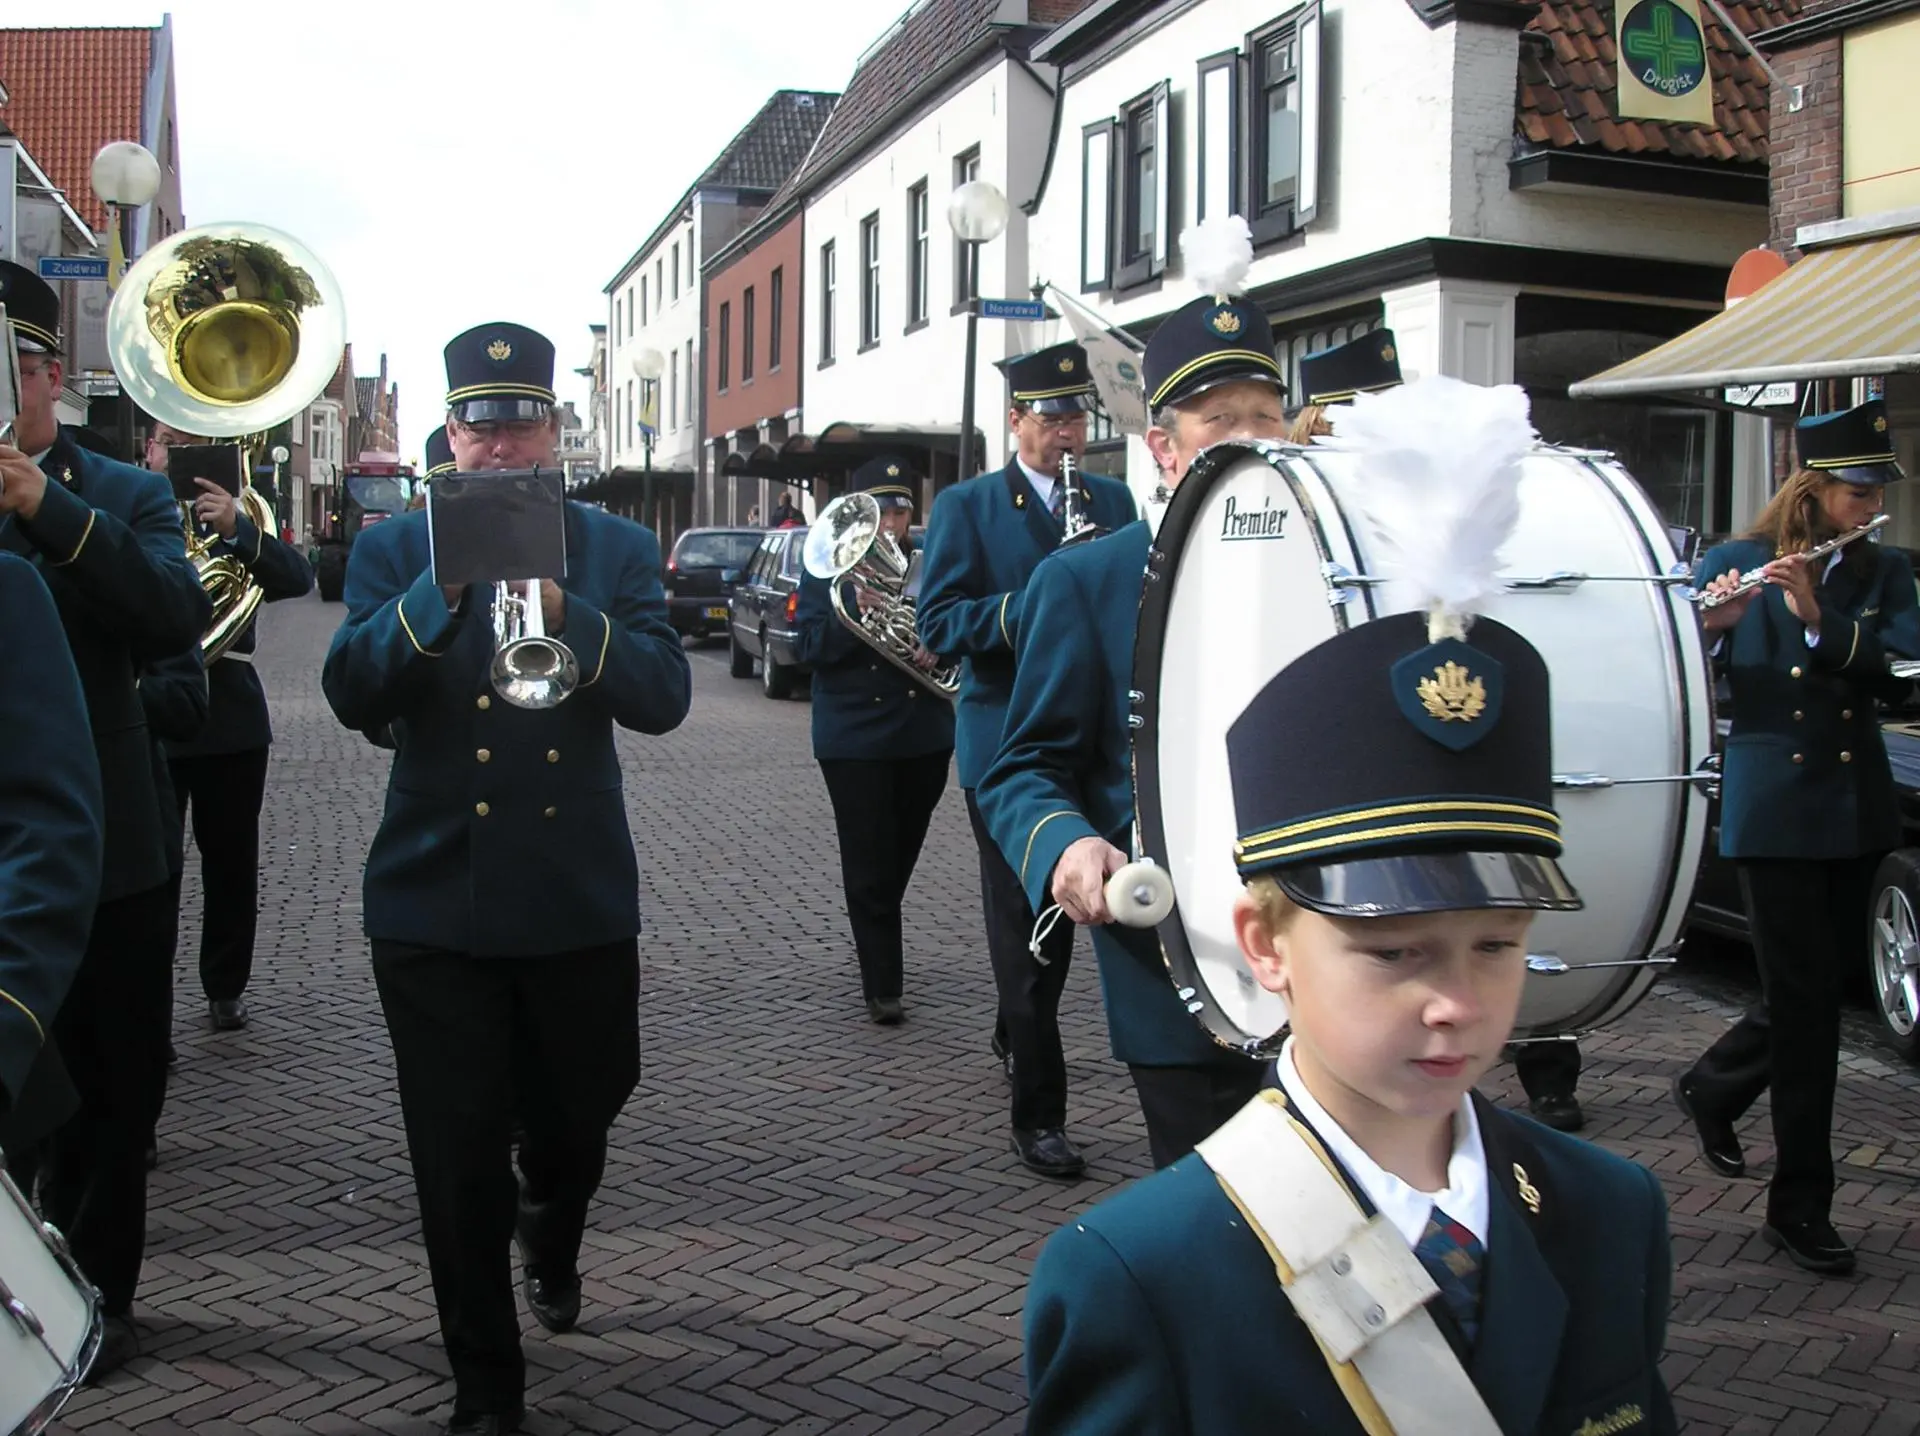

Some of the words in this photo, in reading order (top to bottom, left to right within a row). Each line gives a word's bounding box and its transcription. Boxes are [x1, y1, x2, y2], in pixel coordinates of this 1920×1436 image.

[1642, 67, 1694, 95] Drogist
[52, 262, 102, 274] Zuidwal
[989, 303, 1038, 316] Noordwal
[1221, 495, 1288, 536] Premier
